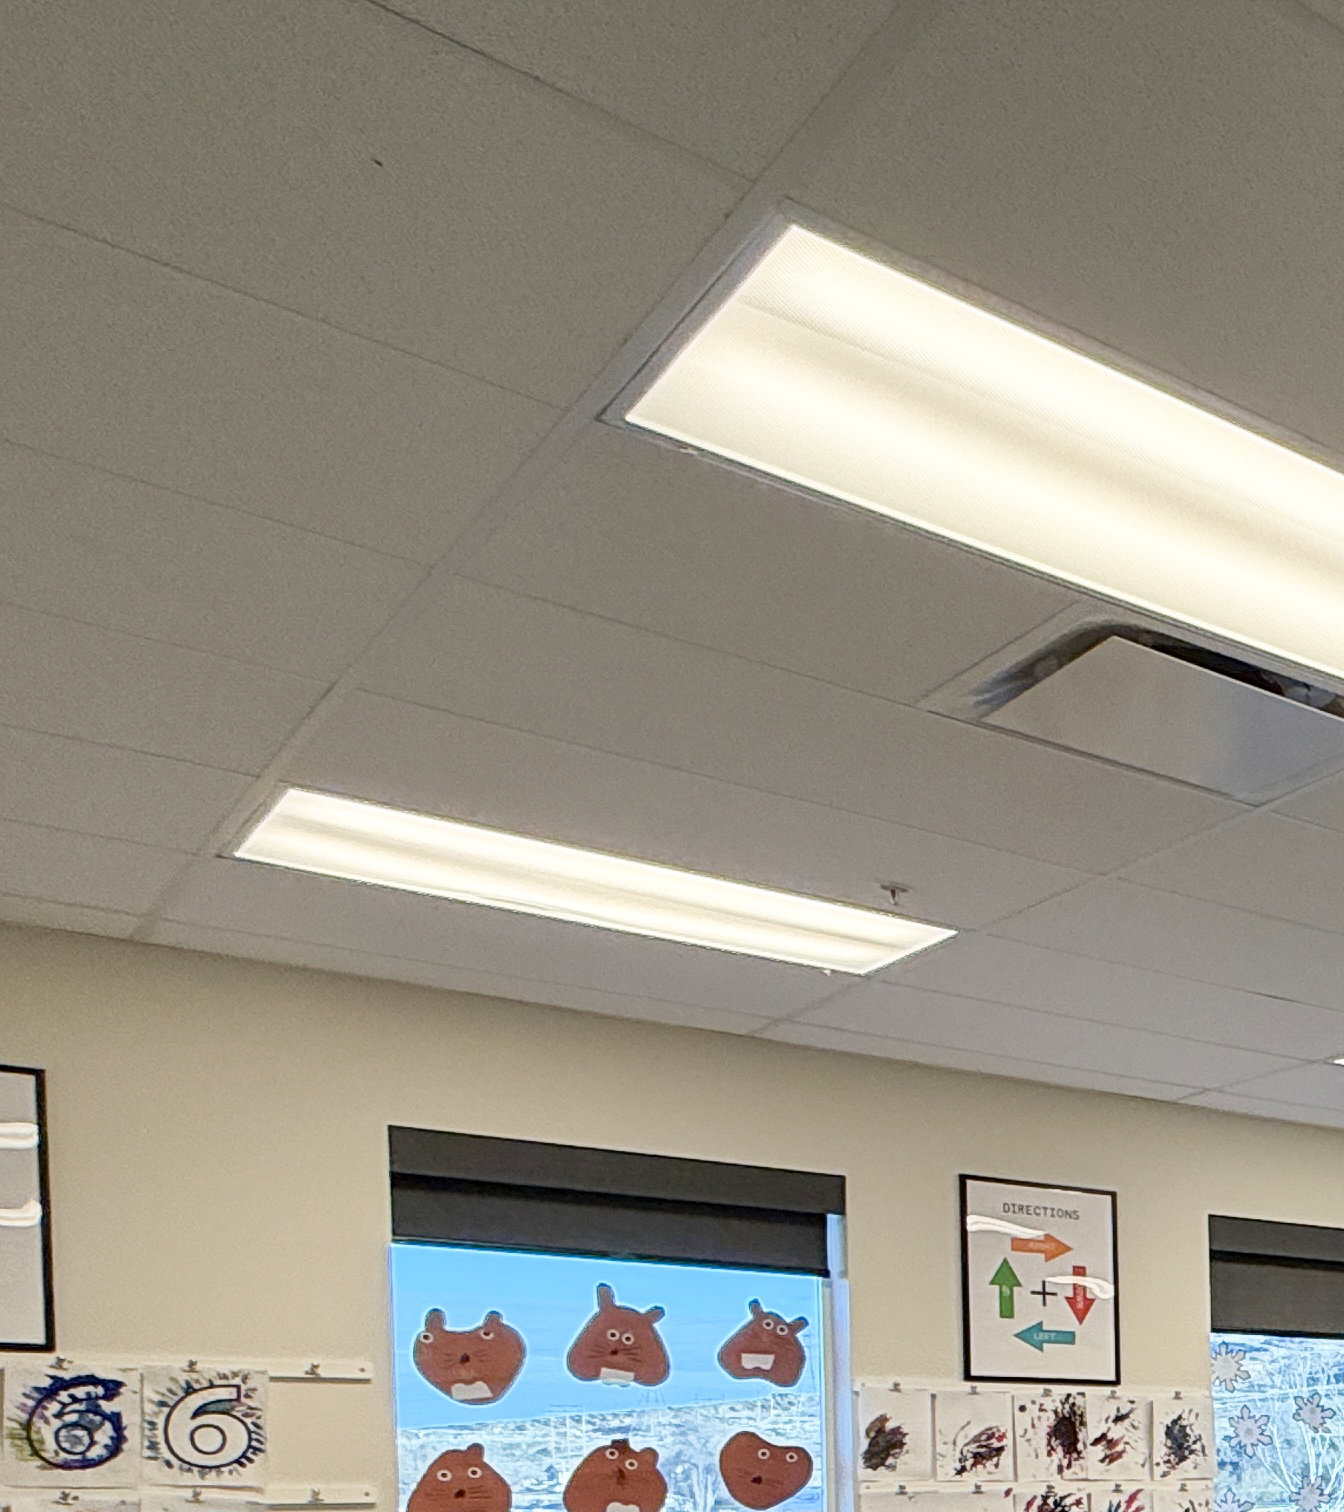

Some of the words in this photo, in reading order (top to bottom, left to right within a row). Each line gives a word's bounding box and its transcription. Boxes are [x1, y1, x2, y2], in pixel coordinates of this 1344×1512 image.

[1002, 1202, 1080, 1220] DIRECTIONS
[1033, 1332, 1056, 1340] LEFT
[164, 1384, 253, 1468] 6
